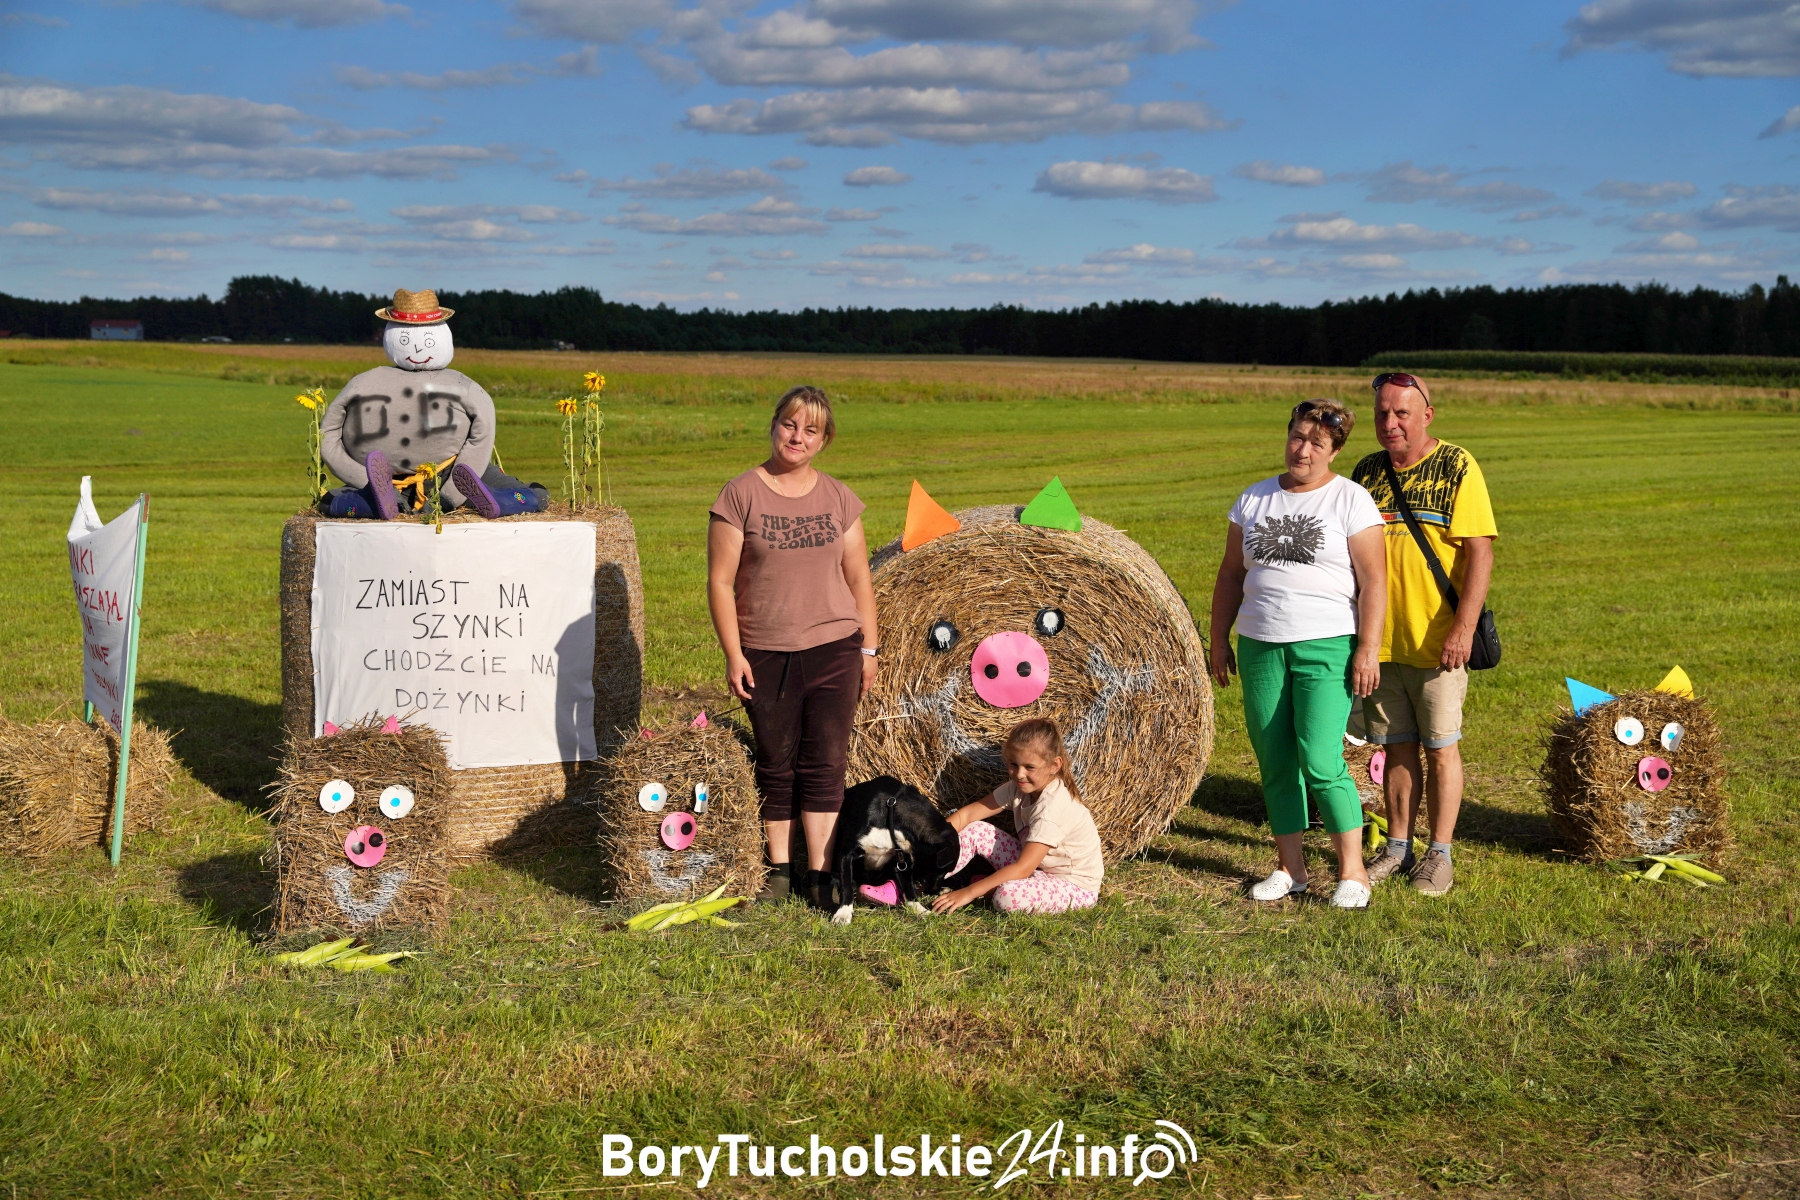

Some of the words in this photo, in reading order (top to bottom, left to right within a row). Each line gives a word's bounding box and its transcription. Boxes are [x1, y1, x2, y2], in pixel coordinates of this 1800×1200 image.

[760, 513, 791, 531] THE
[795, 513, 832, 526] BEST
[761, 527, 777, 542] IS
[782, 524, 811, 541] YET
[815, 520, 837, 532] TO
[778, 532, 826, 550] COME
[355, 570, 470, 610] ZAMIAST
[499, 583, 530, 609] NA
[412, 612, 523, 640] SZYNKI
[363, 648, 507, 676] CHODŹCIE
[531, 654, 556, 677] NA
[395, 687, 525, 714] DOŻYNKI
